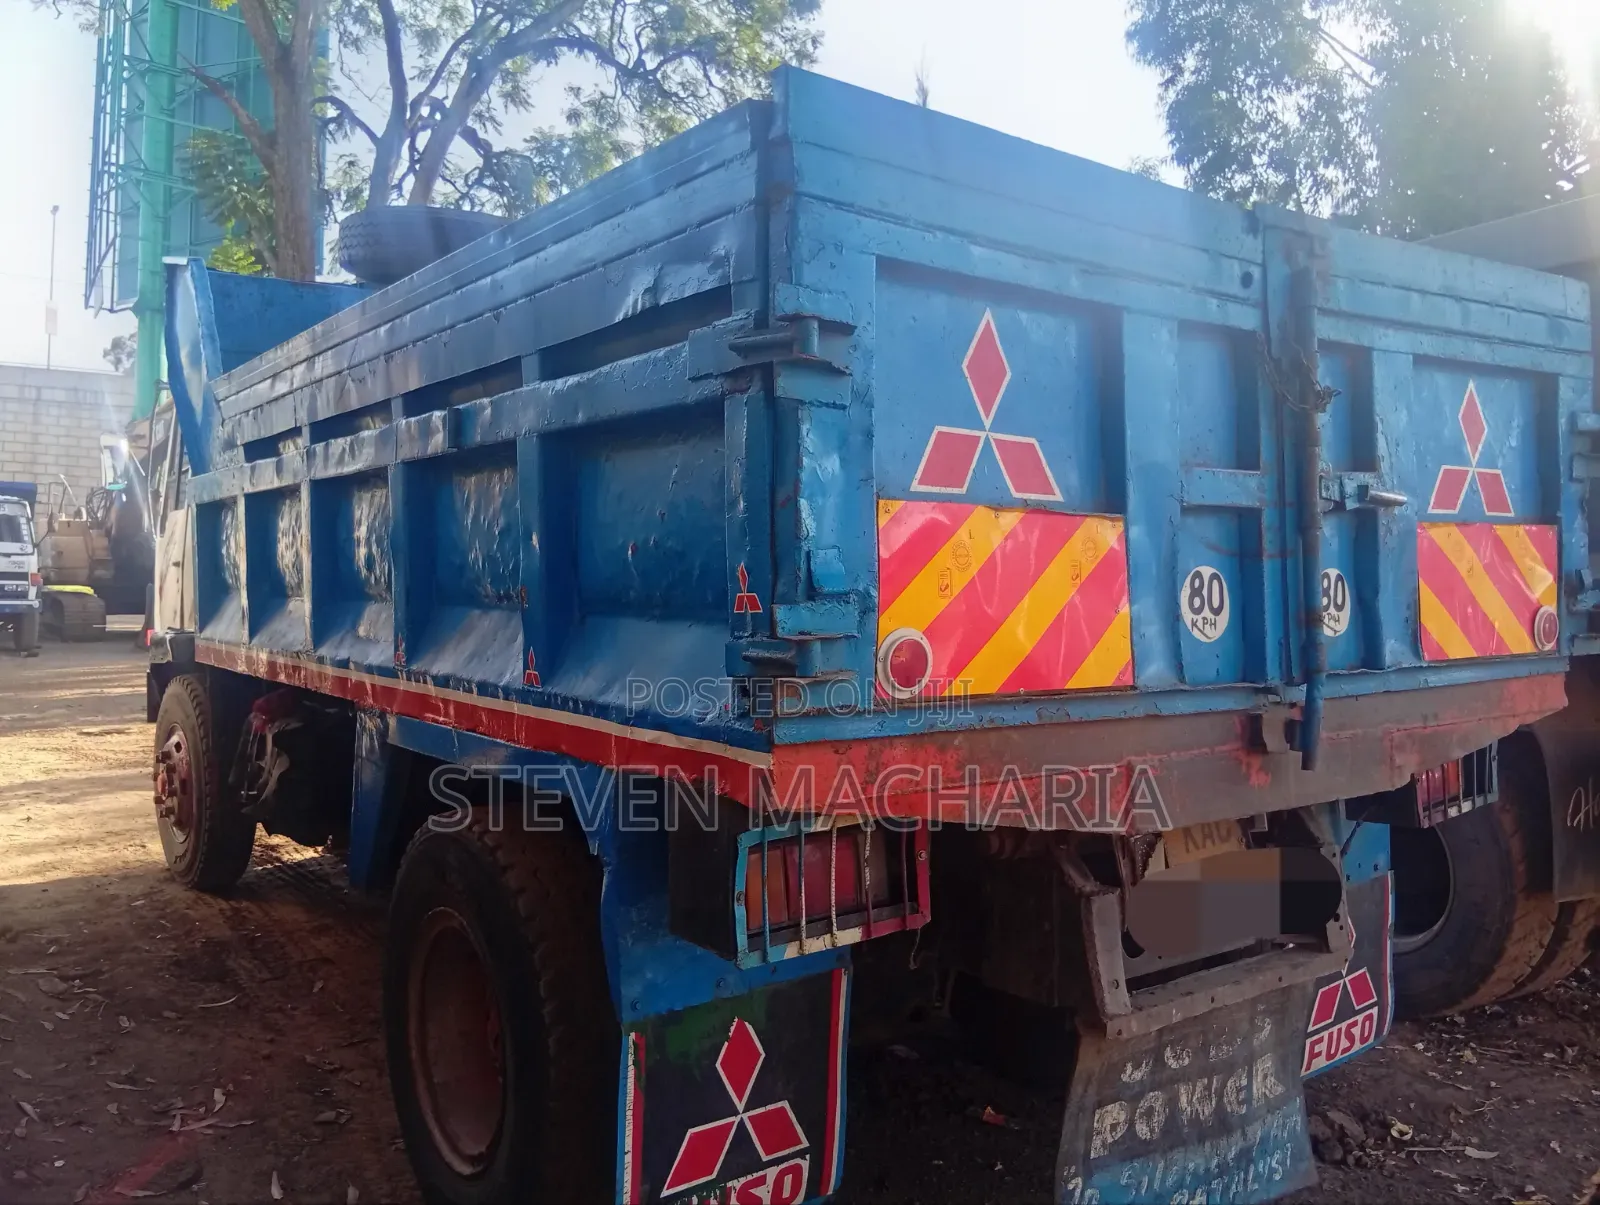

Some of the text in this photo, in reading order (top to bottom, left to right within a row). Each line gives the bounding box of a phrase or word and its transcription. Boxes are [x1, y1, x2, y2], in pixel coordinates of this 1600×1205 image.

[1188, 570, 1224, 616] 80
[1321, 571, 1346, 612] 80
[1191, 616, 1217, 640] KPH
[1304, 1011, 1376, 1073] FUSO
[1089, 1052, 1286, 1160] POWER
